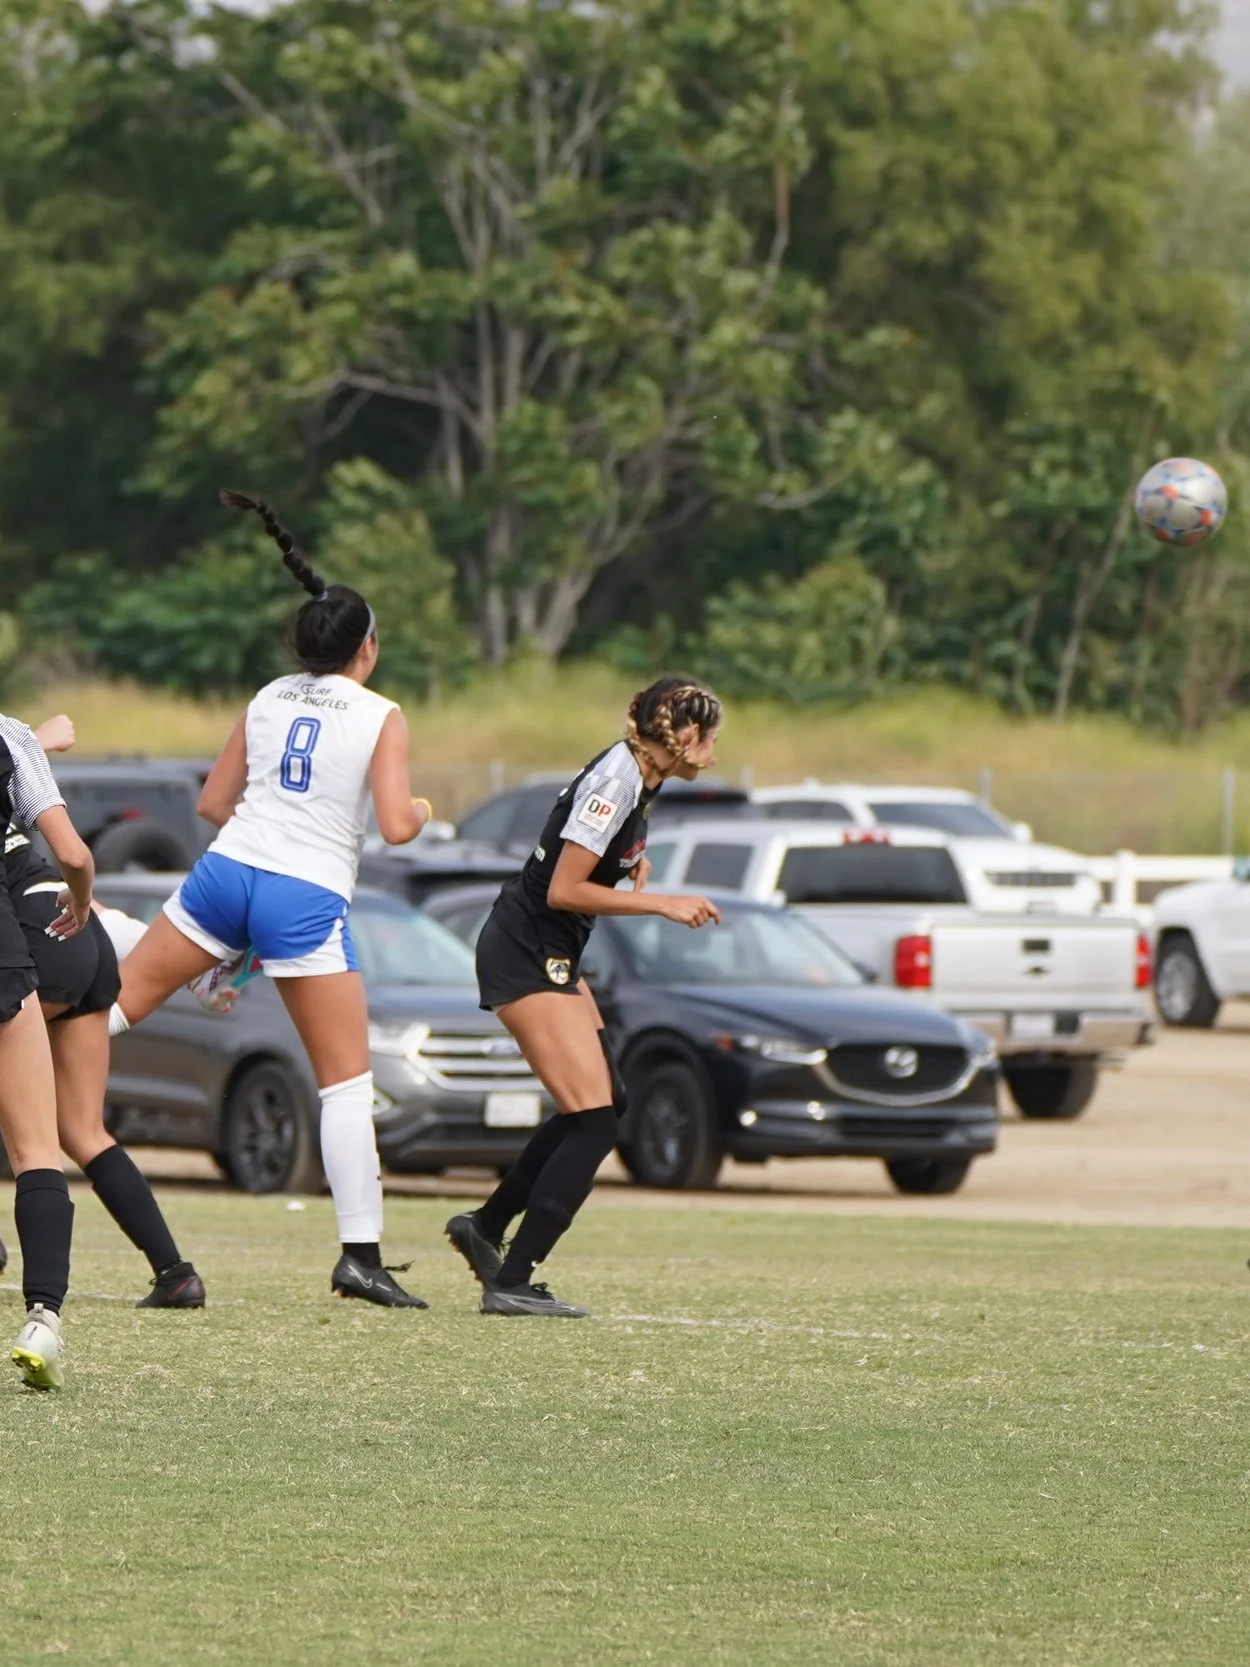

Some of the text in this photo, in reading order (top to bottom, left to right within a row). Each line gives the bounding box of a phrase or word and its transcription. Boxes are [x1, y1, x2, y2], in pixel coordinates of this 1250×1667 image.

[303, 685, 332, 695] SURF
[277, 690, 350, 711] LOS ANGELES
[280, 716, 322, 793] 8
[588, 799, 612, 817] DP
